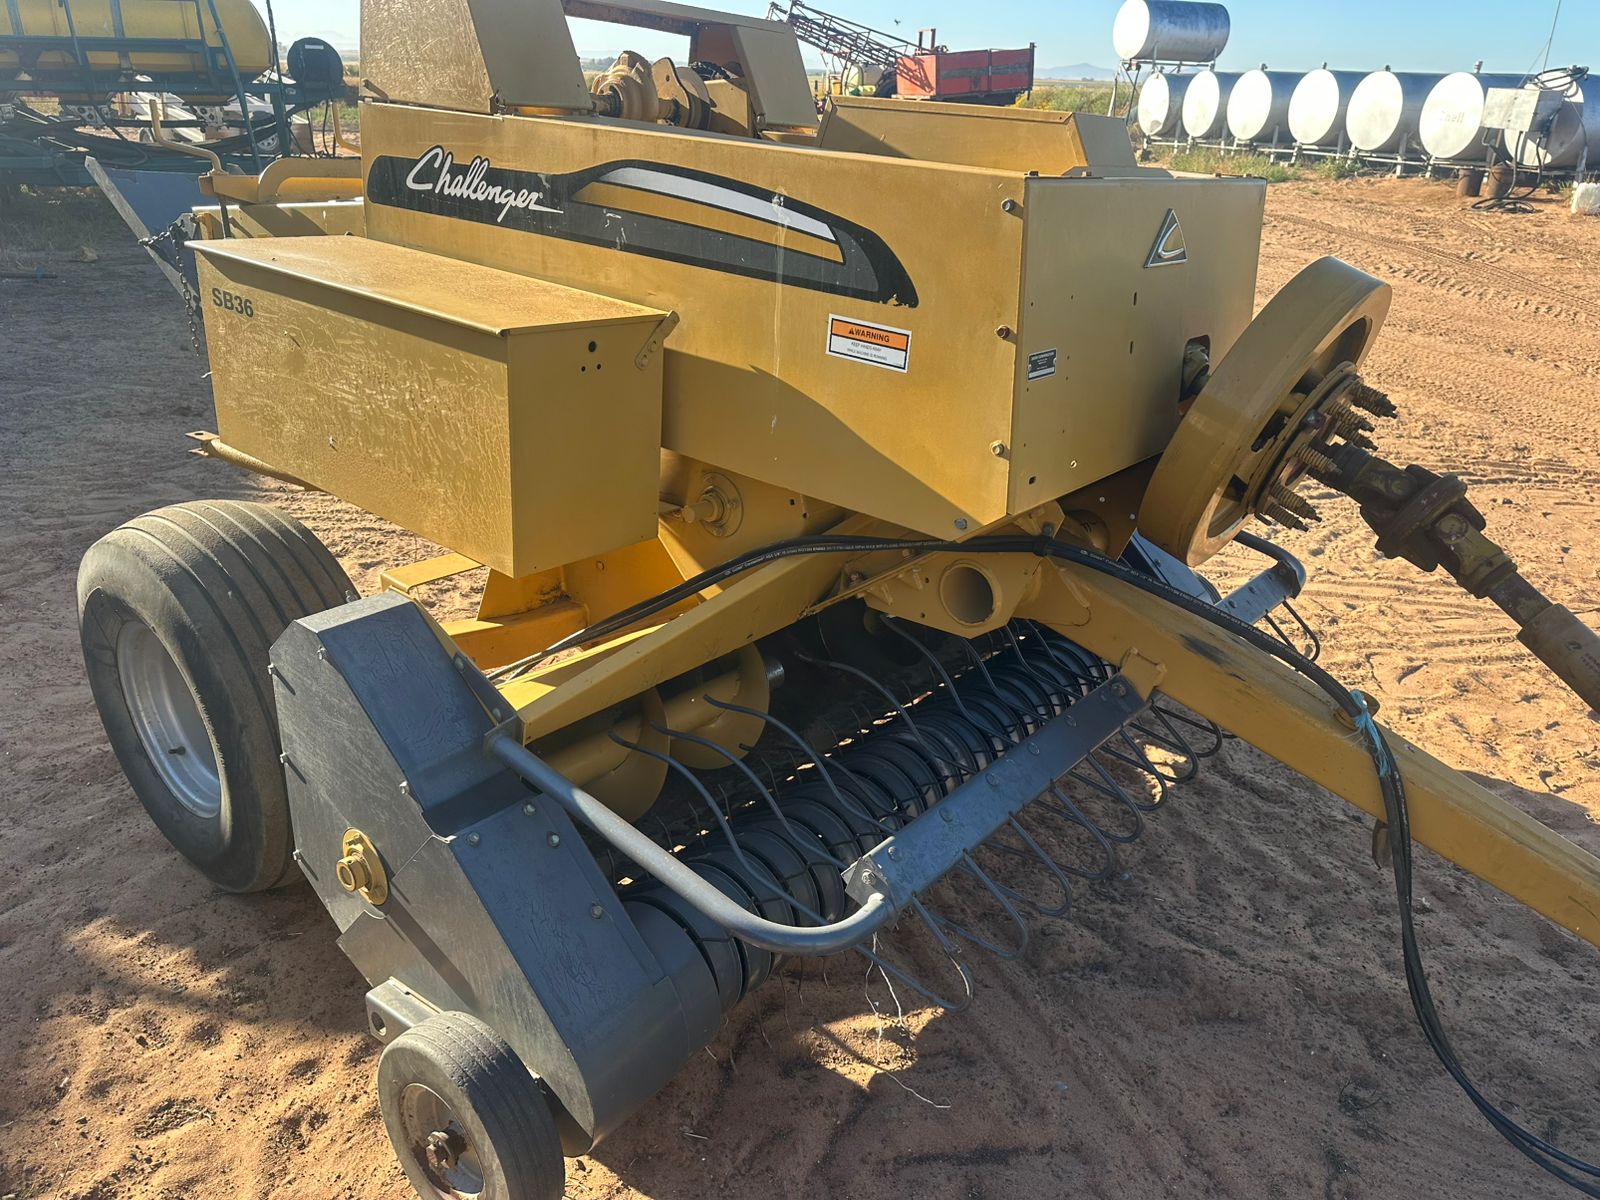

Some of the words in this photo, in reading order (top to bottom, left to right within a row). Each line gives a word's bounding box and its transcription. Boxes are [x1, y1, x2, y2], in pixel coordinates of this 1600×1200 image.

[405, 146, 564, 223] Challenger
[212, 287, 254, 318] SB36
[855, 328, 890, 343] WARNING
